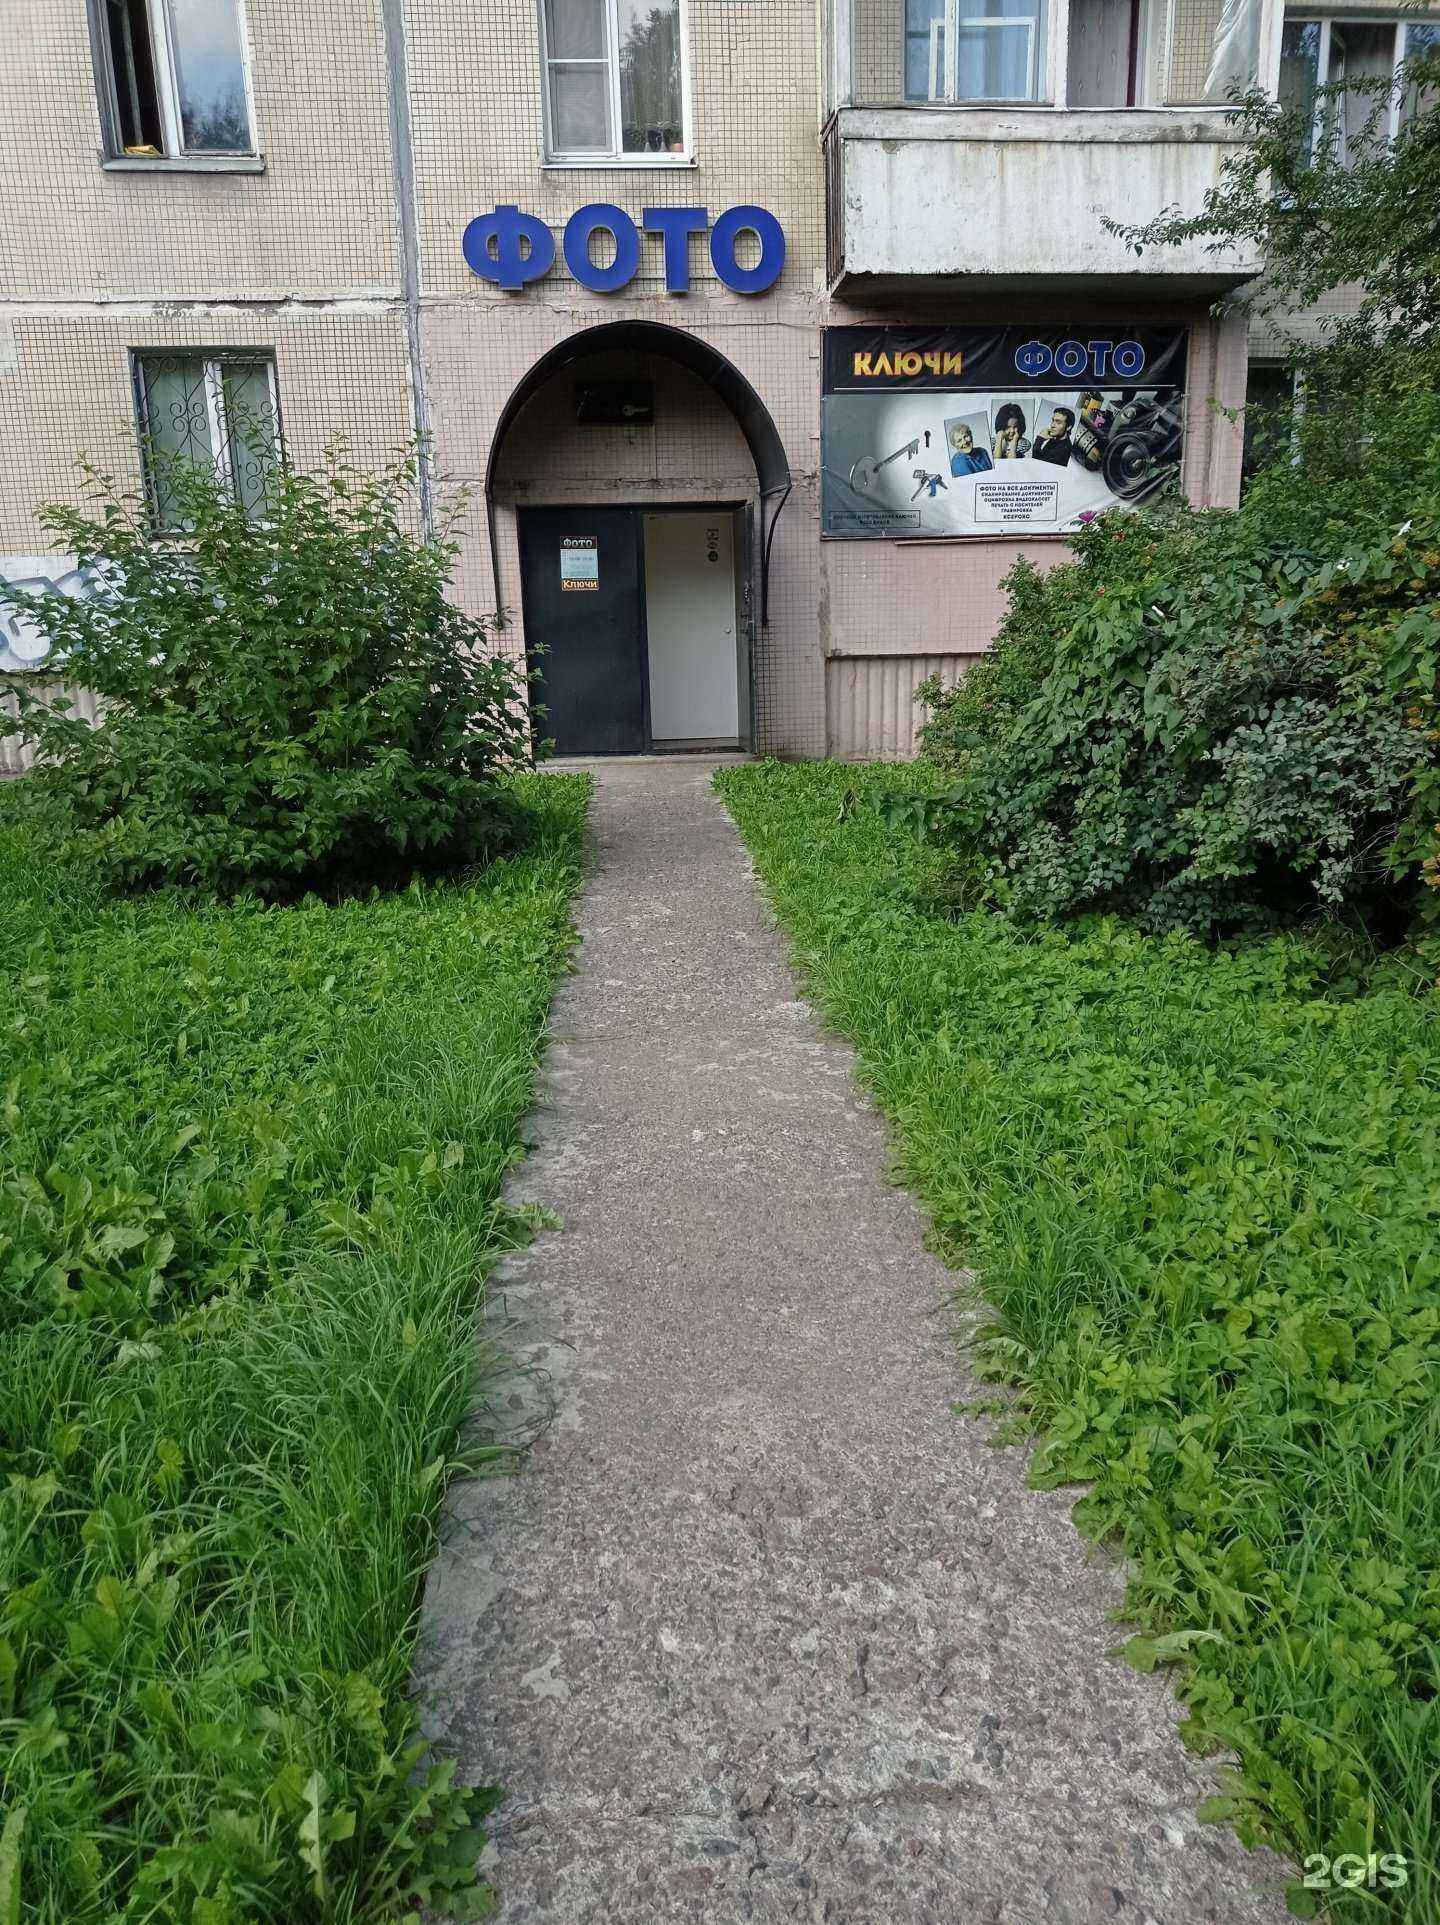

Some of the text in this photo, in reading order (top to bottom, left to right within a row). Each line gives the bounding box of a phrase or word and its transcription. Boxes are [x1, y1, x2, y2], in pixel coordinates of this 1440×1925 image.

[462, 203, 786, 294] ФОТО
[854, 352, 962, 376] КЛЮЧИ
[1015, 341, 1145, 377] ФОТО
